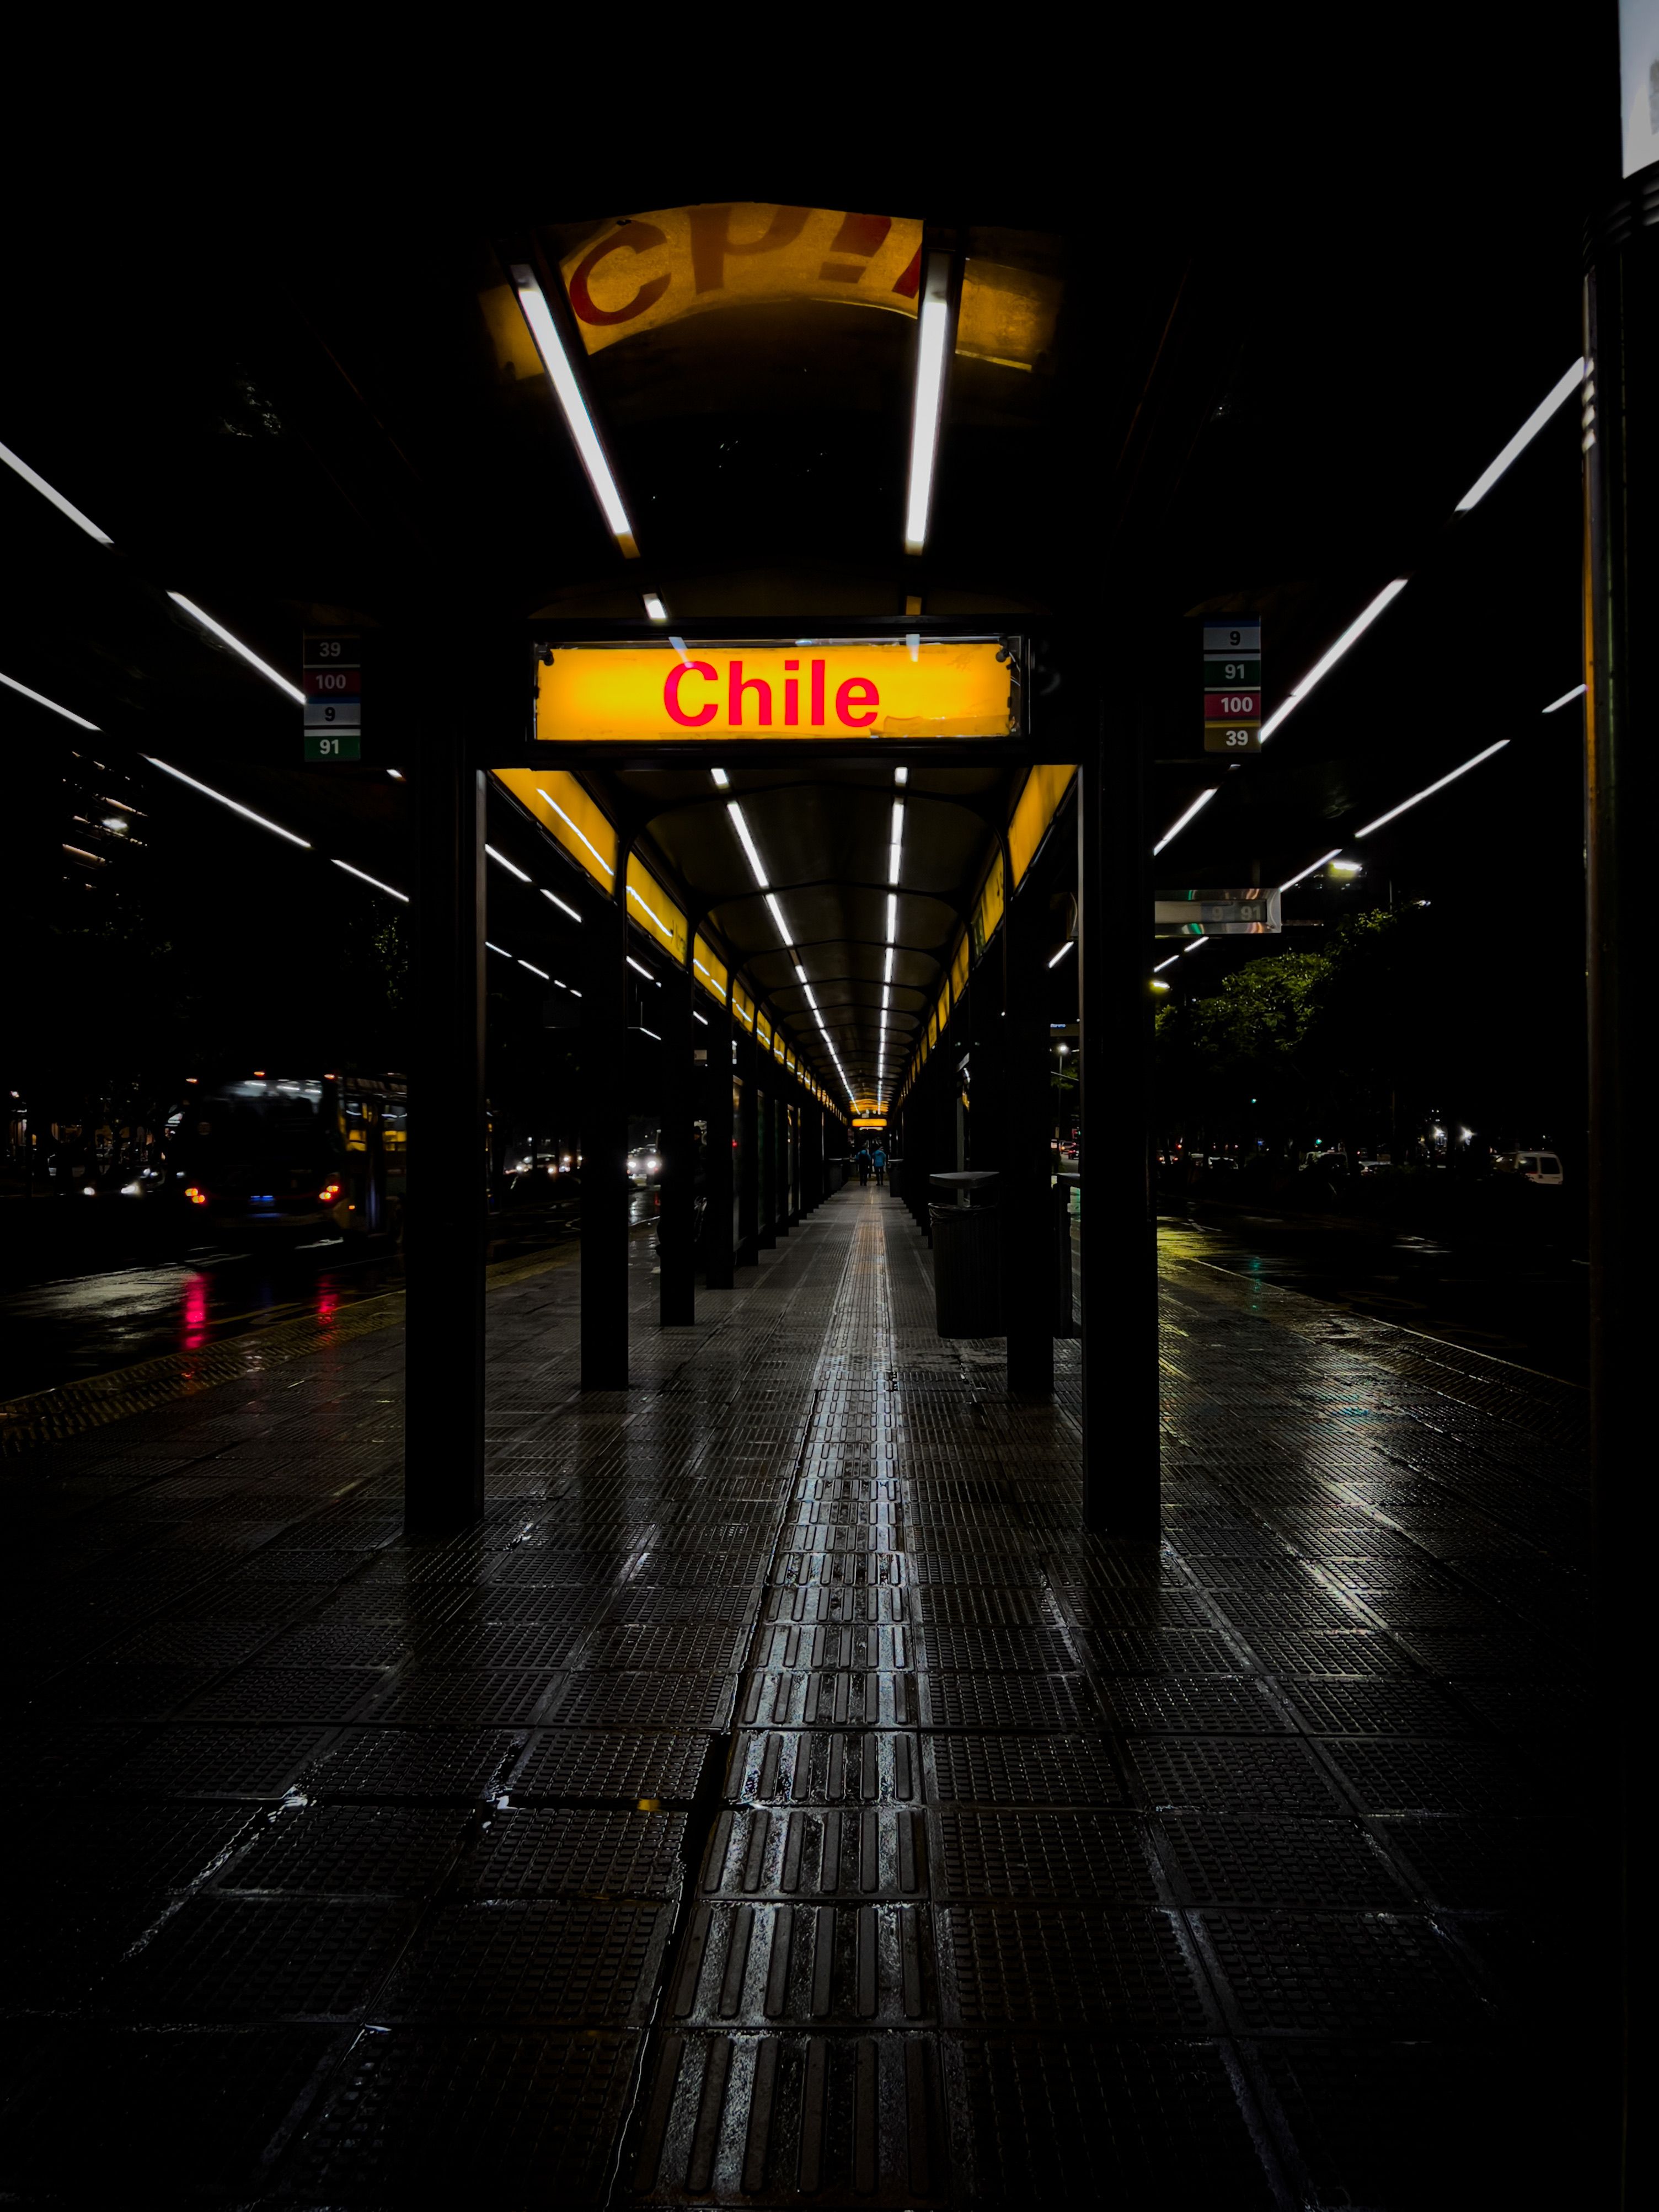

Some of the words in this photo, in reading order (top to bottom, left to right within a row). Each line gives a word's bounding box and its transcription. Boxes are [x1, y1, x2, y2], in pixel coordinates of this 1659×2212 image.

[1230, 630, 1240, 645] 9
[319, 641, 341, 657] 39
[1224, 663, 1245, 679] 91
[315, 674, 347, 689] 100
[663, 660, 880, 727] Chile
[1221, 697, 1253, 713] 100
[325, 706, 335, 722] 9
[1225, 730, 1249, 746] 39
[319, 739, 340, 754] 91
[1212, 906, 1224, 922] 9
[1240, 905, 1261, 921] 91
